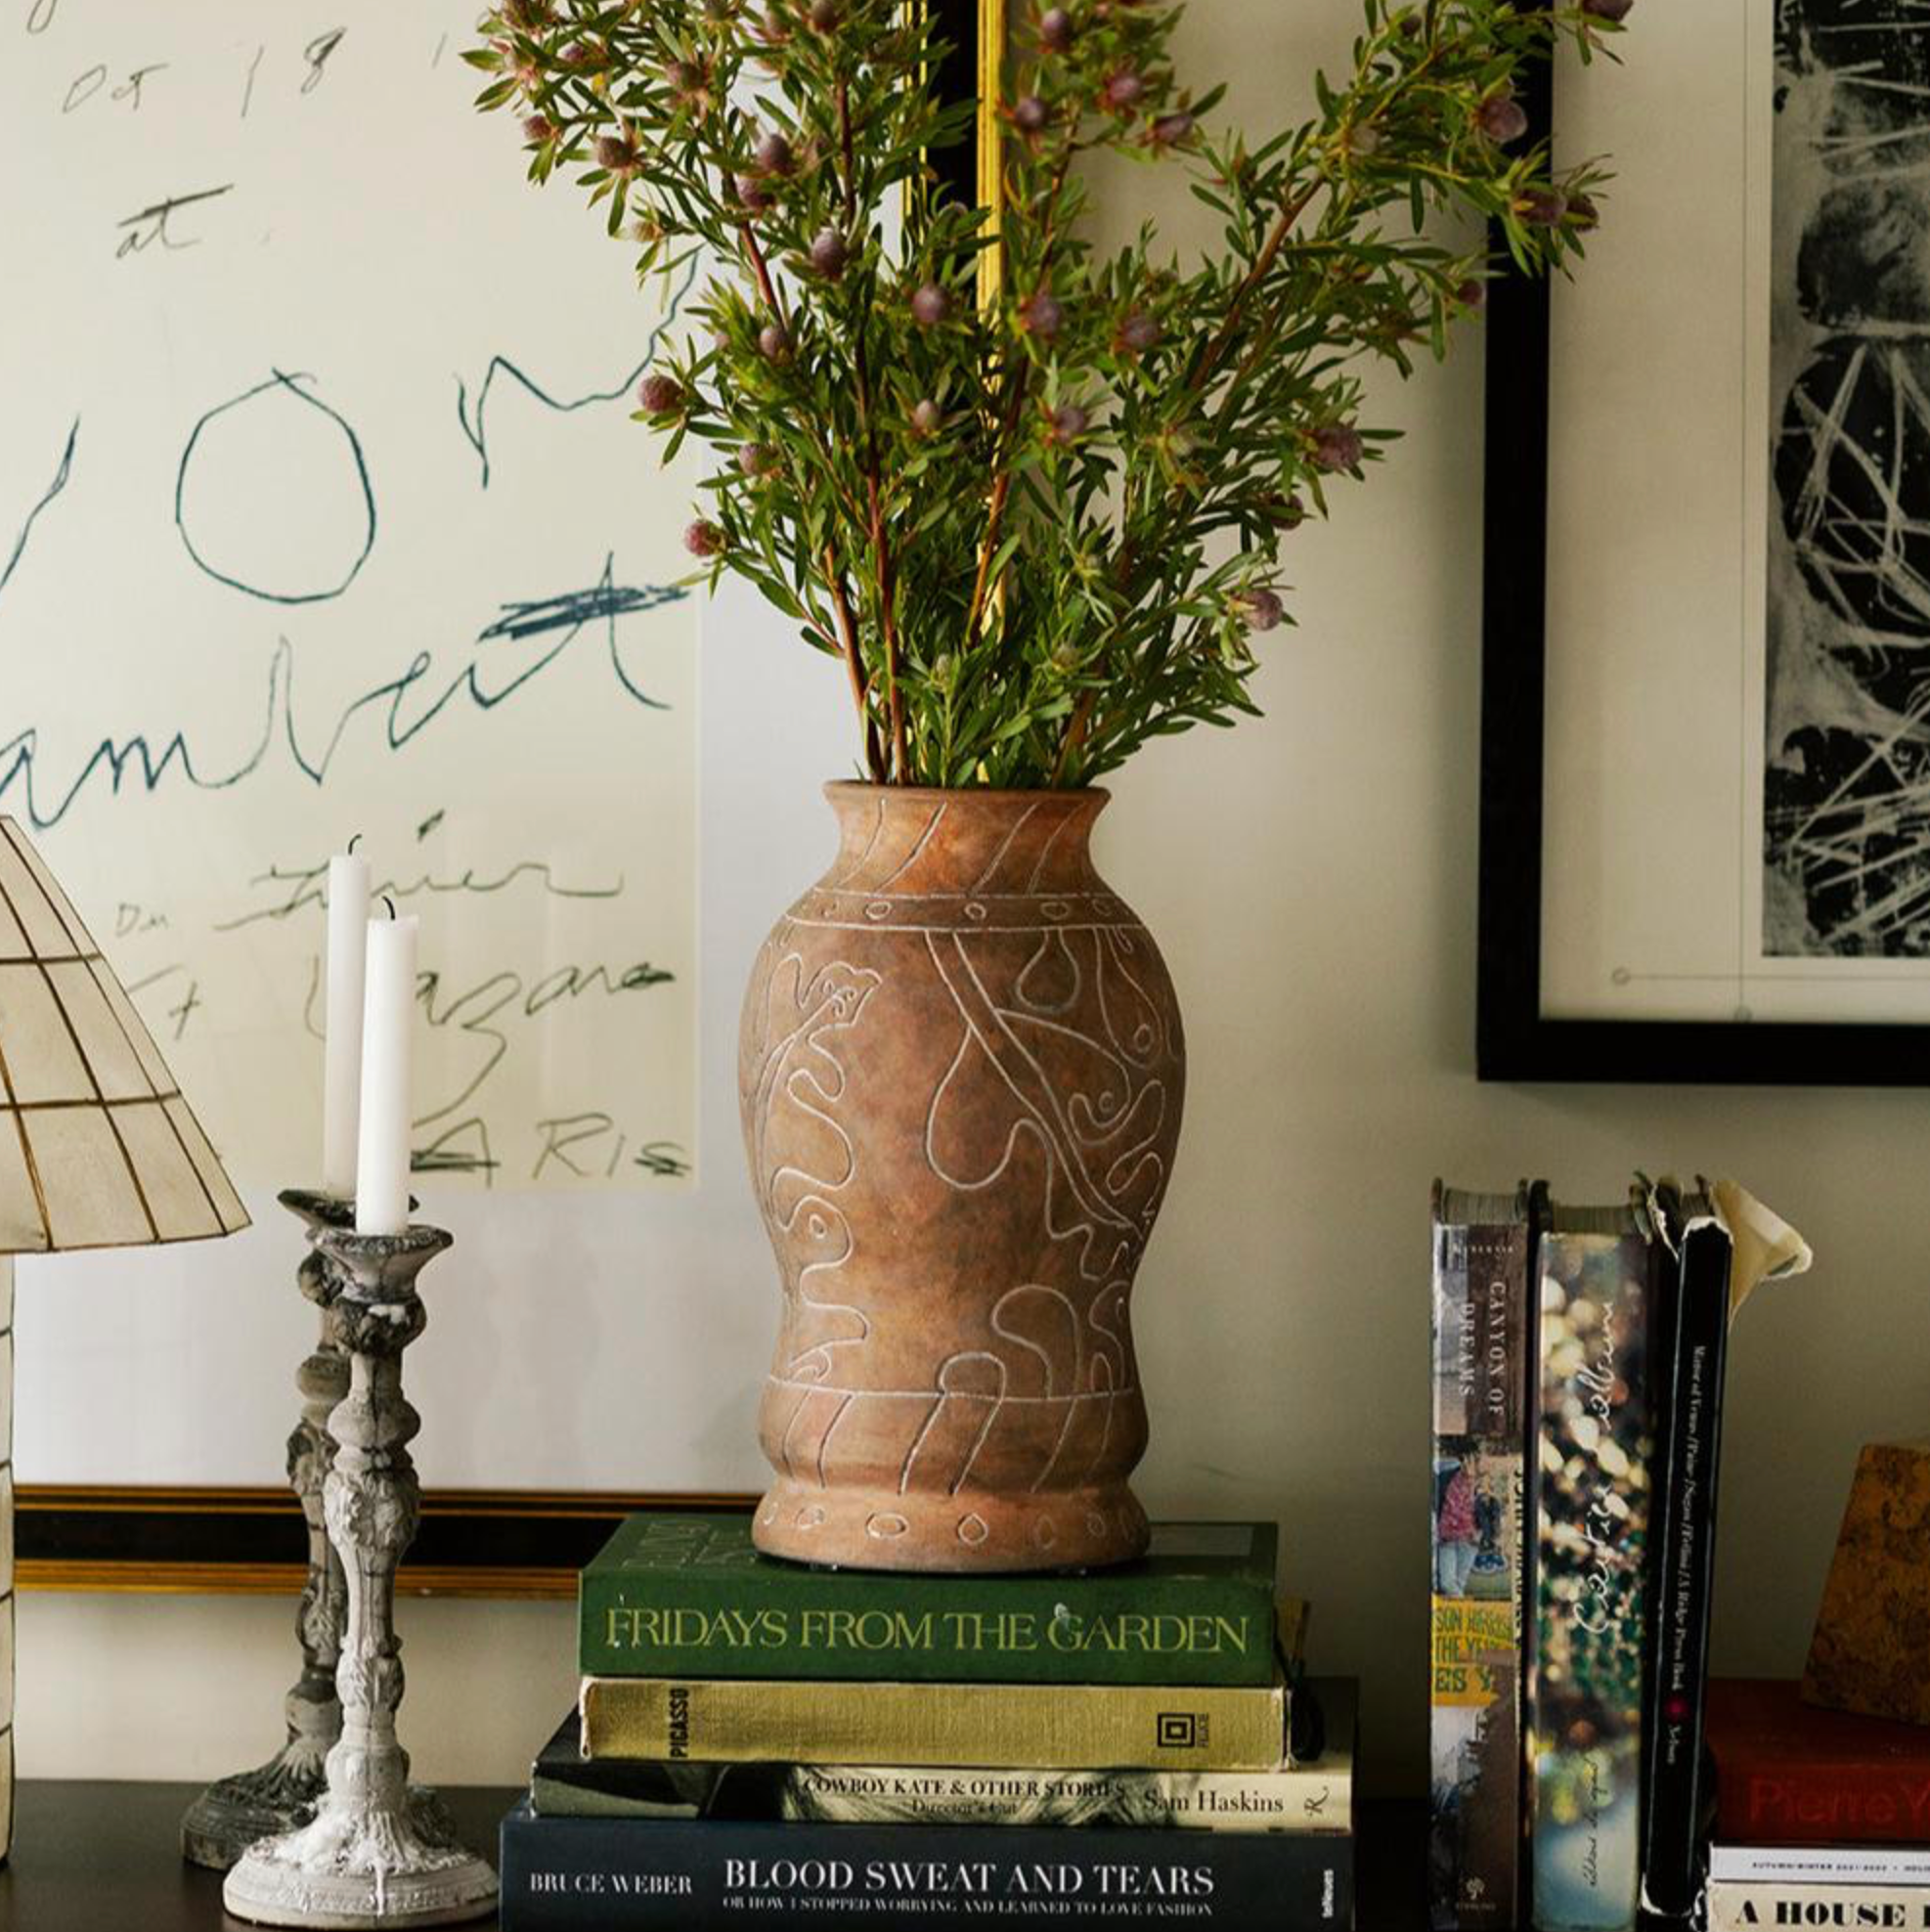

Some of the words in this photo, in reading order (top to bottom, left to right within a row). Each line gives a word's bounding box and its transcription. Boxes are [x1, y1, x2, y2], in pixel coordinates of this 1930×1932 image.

[1488, 1281, 1507, 1376] CANYON
[1458, 1301, 1475, 1397] DREAMS
[1488, 1385, 1506, 1417] OF
[604, 1607, 787, 1649] FRIDAYS
[800, 1609, 935, 1650] FROM
[943, 1612, 1037, 1651] THE
[1047, 1614, 1250, 1654] GARDEN
[670, 1688, 690, 1758] PICASSO
[804, 1778, 890, 1795] COWBOY
[895, 1778, 944, 1796] KATE
[949, 1778, 967, 1796] &
[970, 1779, 1039, 1797] OTHER
[1044, 1781, 1125, 1798] STORIES
[1143, 1789, 1191, 1813] Sam
[1197, 1790, 1285, 1814] Haskins
[529, 1871, 605, 1894] BRUCE
[610, 1872, 693, 1895] WEBER
[723, 1860, 855, 1890] BLOOD
[864, 1861, 997, 1893] SWEAT
[1005, 1863, 1083, 1894] AND
[1092, 1865, 1214, 1896] TEARS
[748, 1897, 783, 1909] HOW
[800, 1897, 871, 1910] STOPPED
[873, 1898, 957, 1912] WORRYING
[964, 1900, 994, 1913] AND
[997, 1900, 1072, 1914] LEARNED
[1076, 1902, 1097, 1914] TO
[1100, 1902, 1143, 1915] LOVE
[1146, 1902, 1212, 1916] FASHION
[1735, 1899, 1759, 1925] A
[1776, 1900, 1906, 1928] HOUSE
